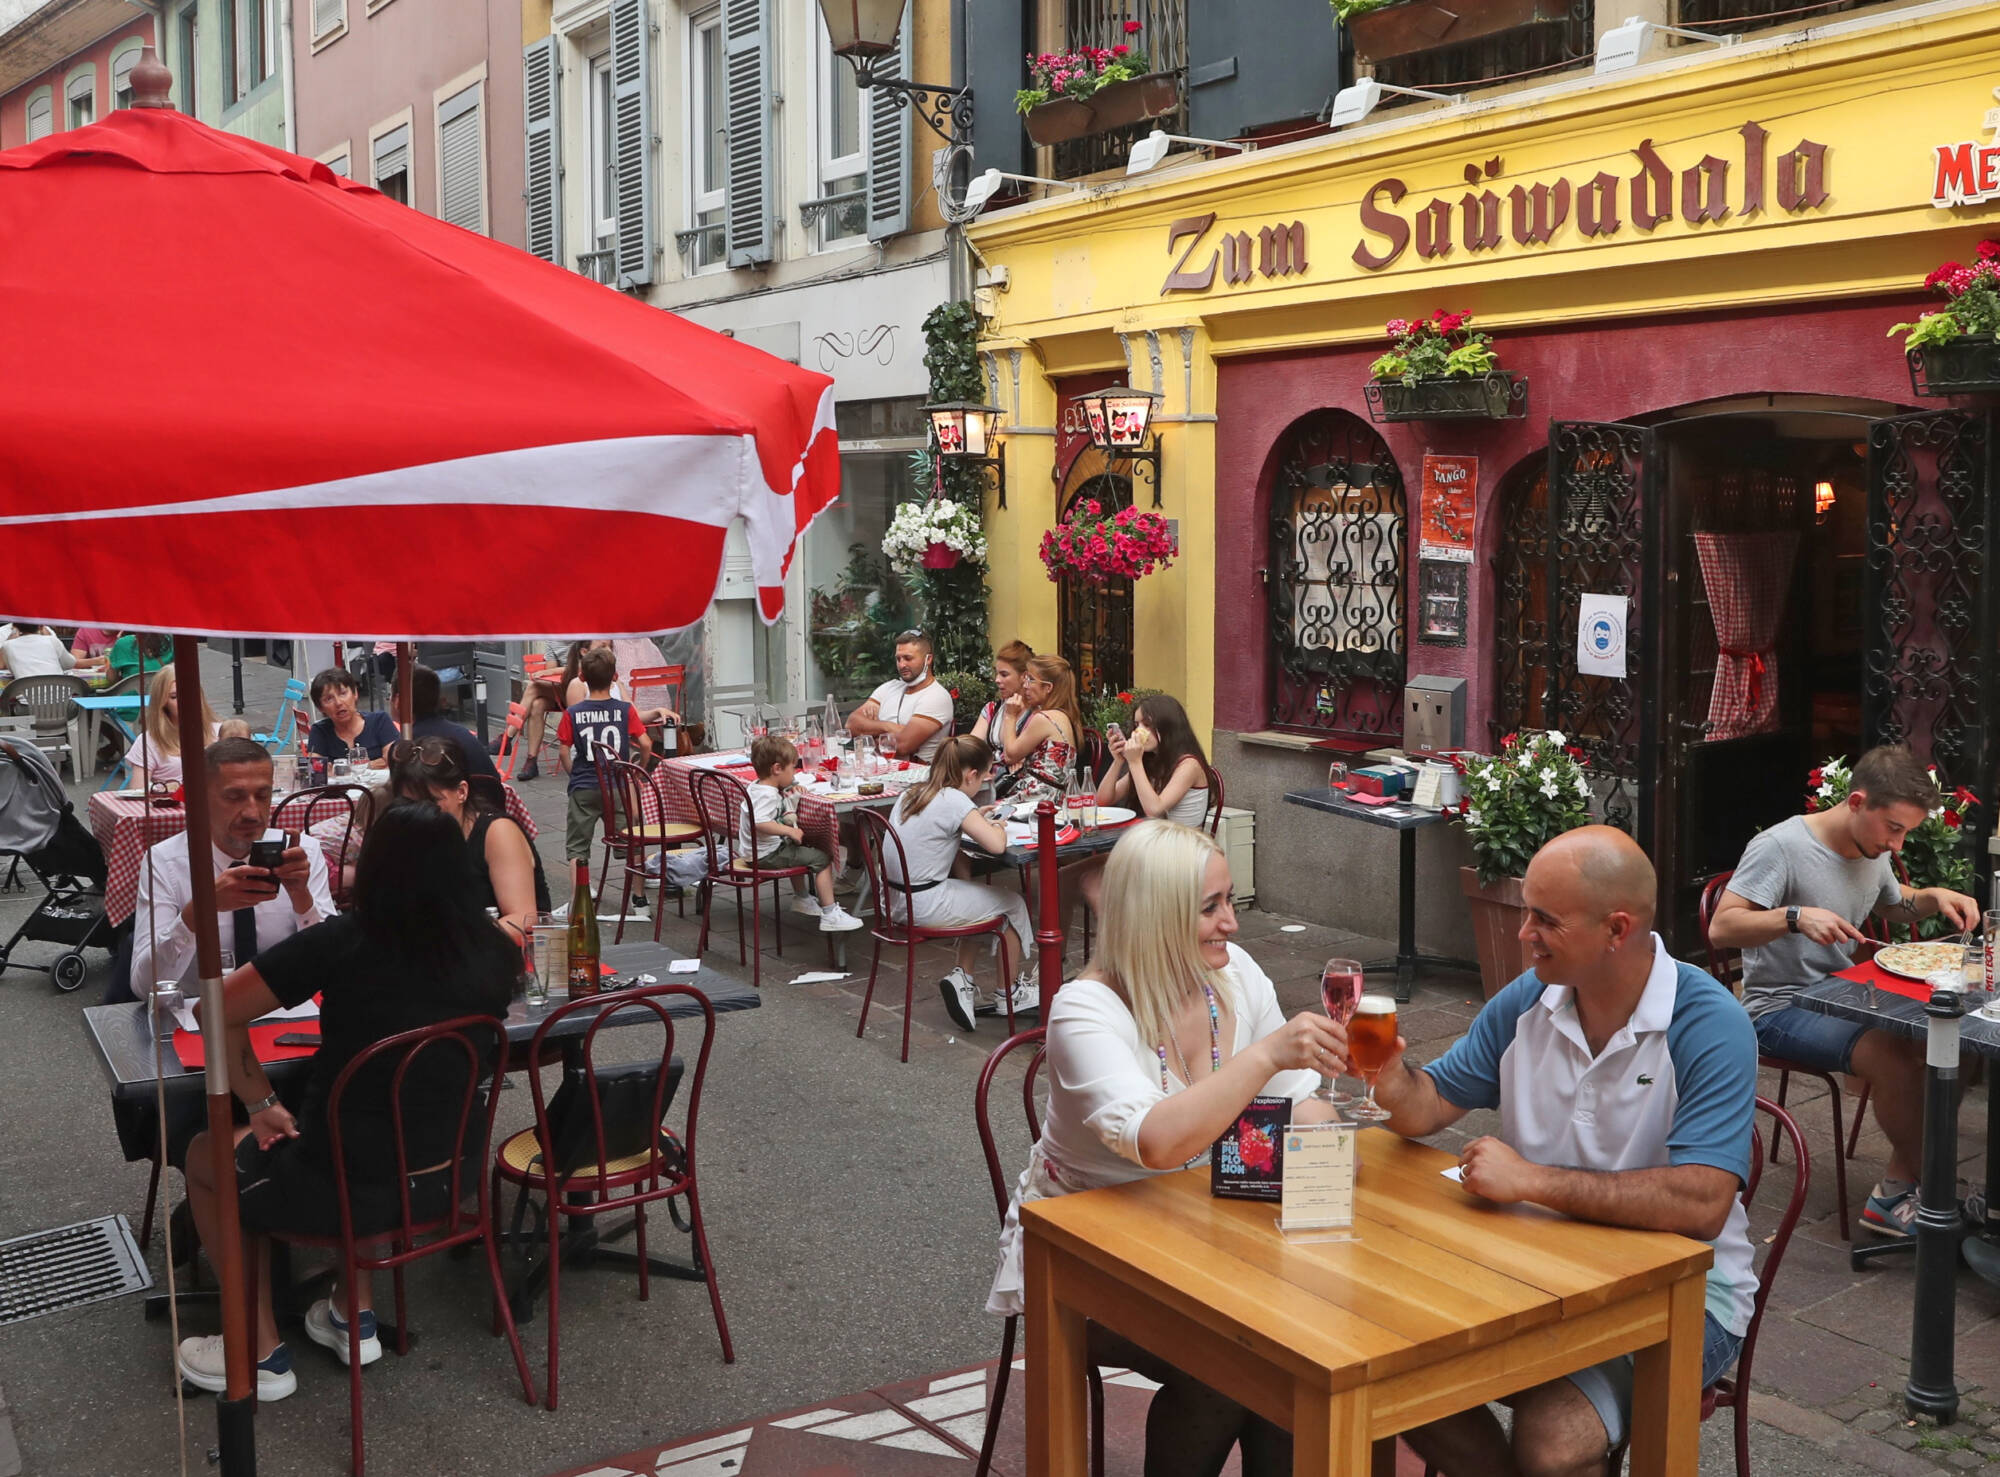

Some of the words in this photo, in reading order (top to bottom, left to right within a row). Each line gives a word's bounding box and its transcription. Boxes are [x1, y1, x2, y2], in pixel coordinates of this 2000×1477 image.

[1934, 142, 2000, 200] ME
[1159, 211, 1309, 297] Zum
[1434, 469, 1466, 483] TANGO
[575, 711, 610, 724] NEYMAR
[613, 709, 622, 722] JR
[579, 725, 621, 762] 10
[1984, 944, 1995, 993] METEOR
[1222, 1145, 1239, 1155] PUL
[1220, 1164, 1245, 1175] SION
[1221, 1155, 1241, 1165] PLO
[1893, 1202, 1916, 1225] N
